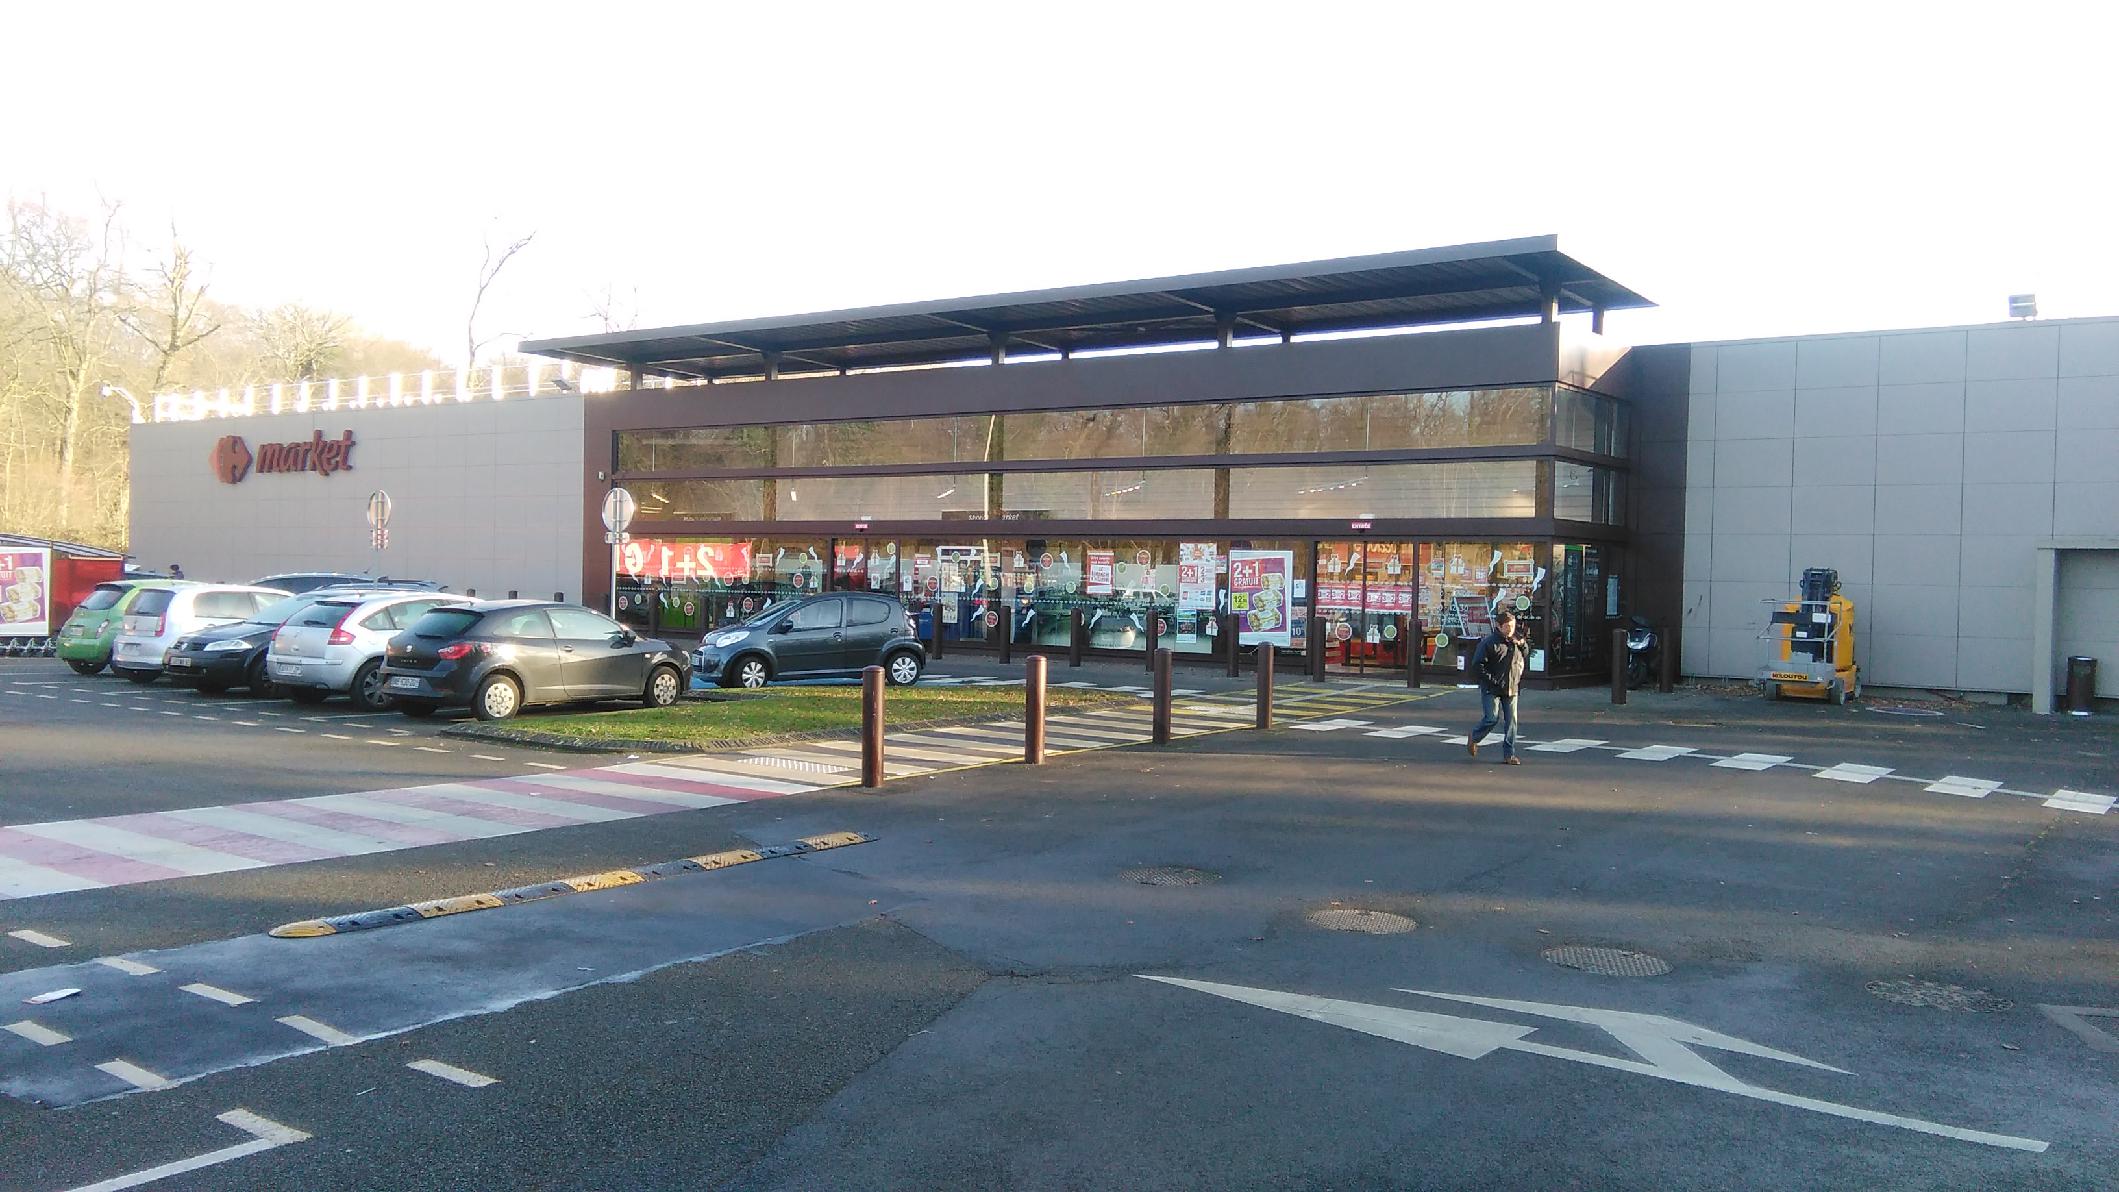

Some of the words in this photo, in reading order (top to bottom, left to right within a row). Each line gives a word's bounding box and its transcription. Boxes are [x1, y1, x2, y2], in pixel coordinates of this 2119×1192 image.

[256, 429, 356, 476] market
[1181, 566, 1198, 577] 2+1
[1233, 561, 1259, 577] 2+1
